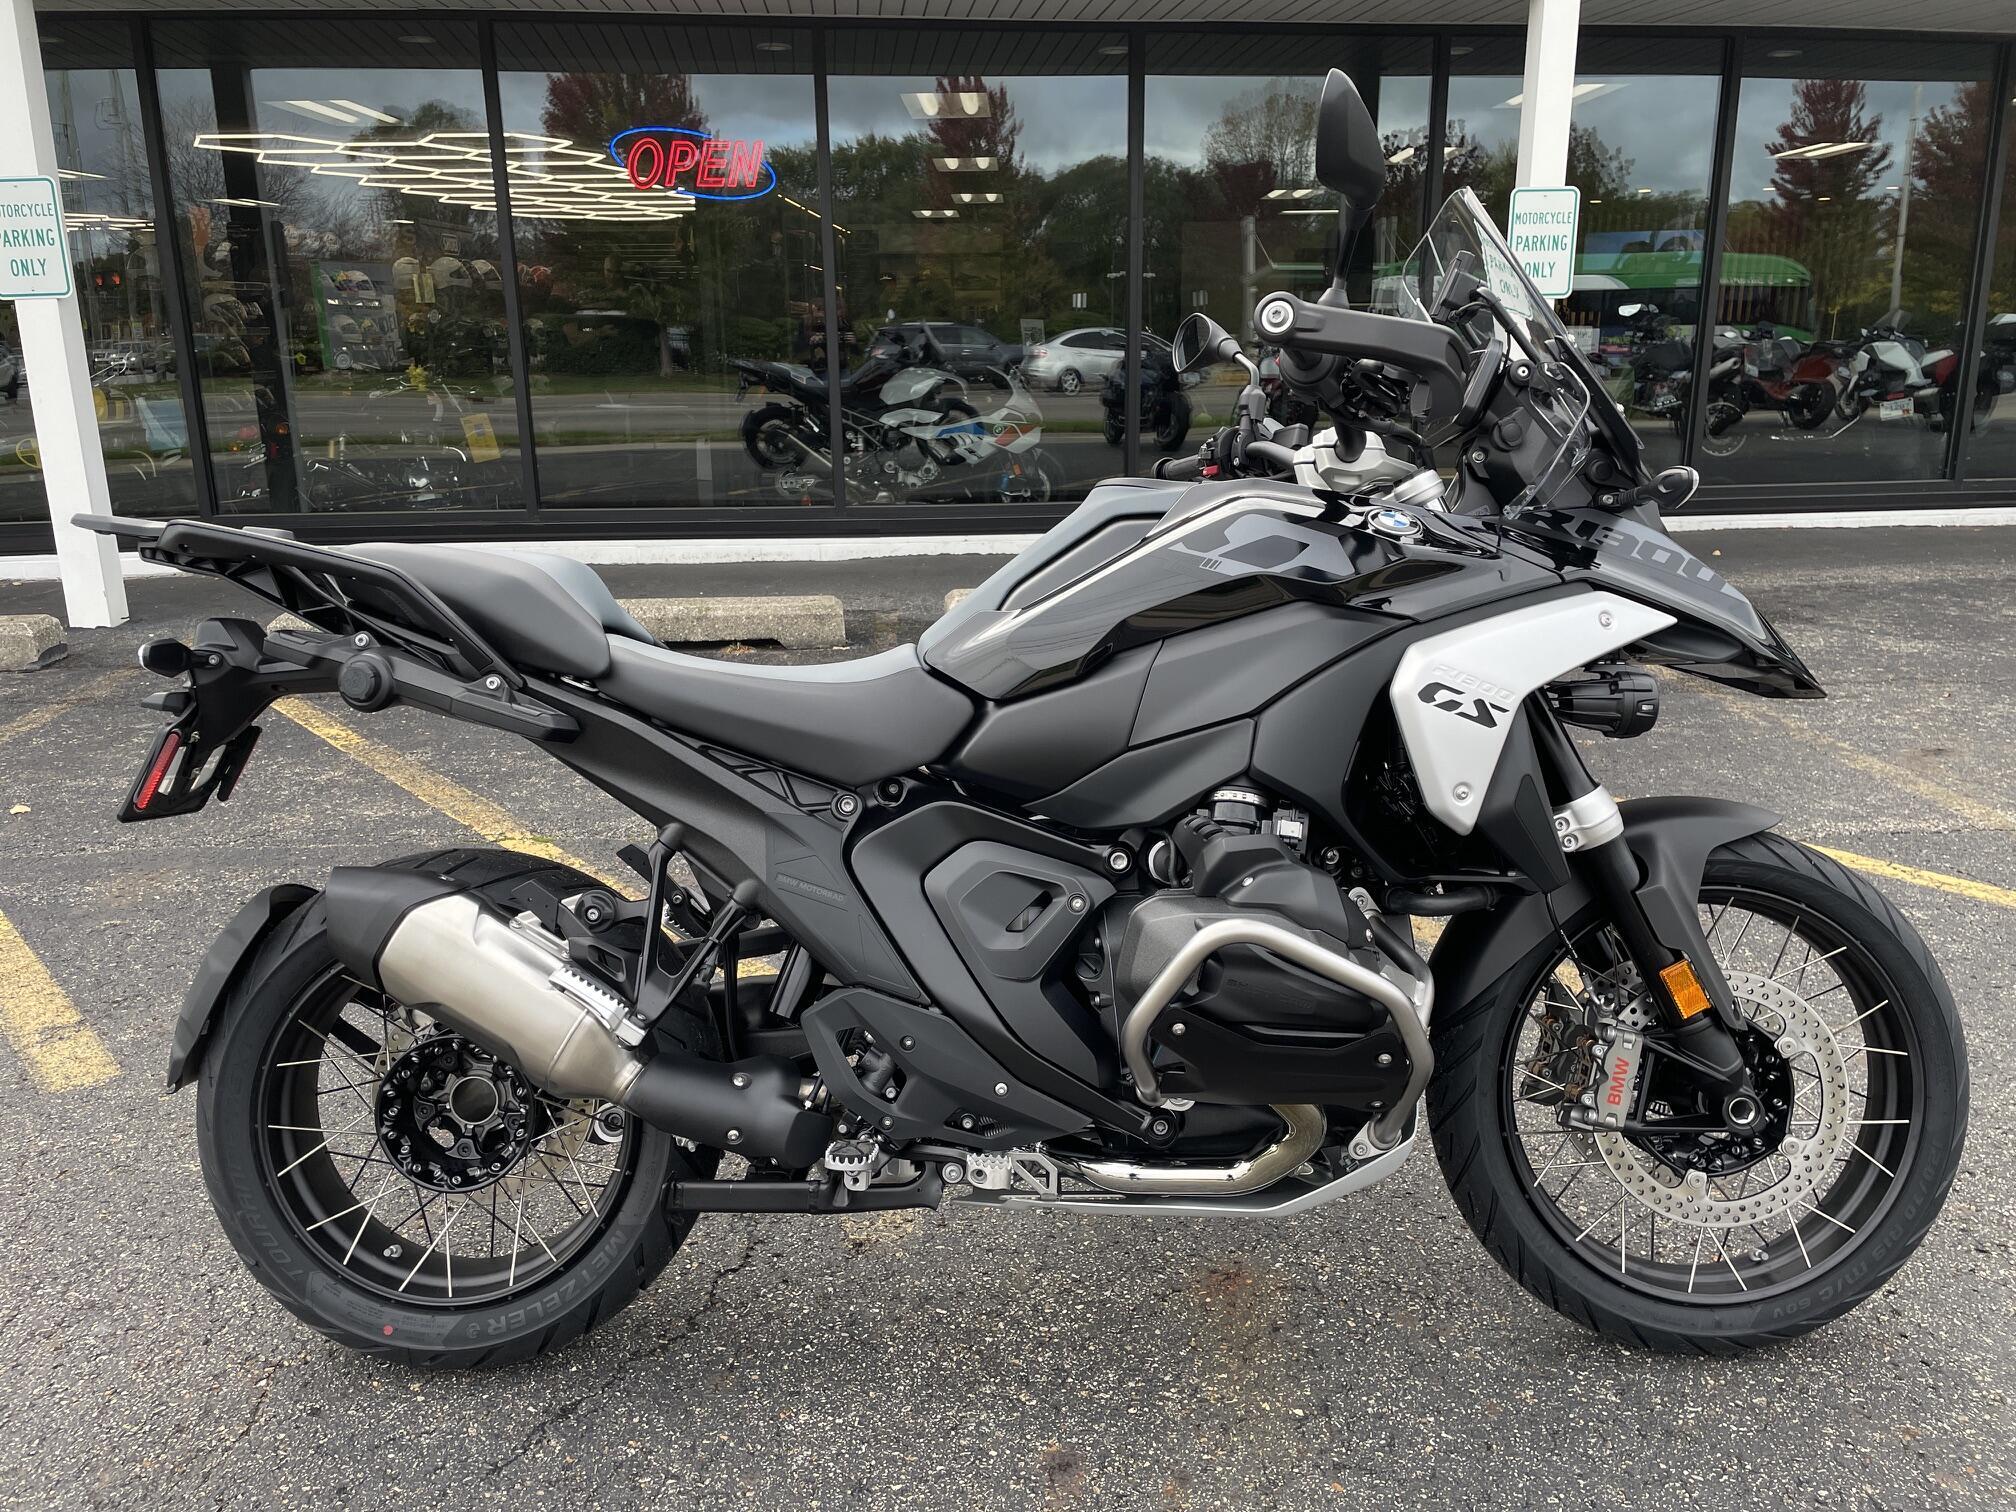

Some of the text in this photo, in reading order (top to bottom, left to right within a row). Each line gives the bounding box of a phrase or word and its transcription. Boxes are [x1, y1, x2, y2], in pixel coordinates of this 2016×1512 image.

[627, 137, 765, 190] OPEN
[0, 203, 54, 217] TORCYCLE
[1514, 211, 1573, 225] MOTORCYCLE
[0, 228, 56, 247] ARKING
[1515, 234, 1569, 251] PARKING
[10, 258, 47, 277] ONLY
[1524, 262, 1556, 278] ONLY
[1417, 681, 1510, 729] GS
[1606, 1055, 1630, 1106] BMW
[486, 1230, 628, 1336] METZELER
